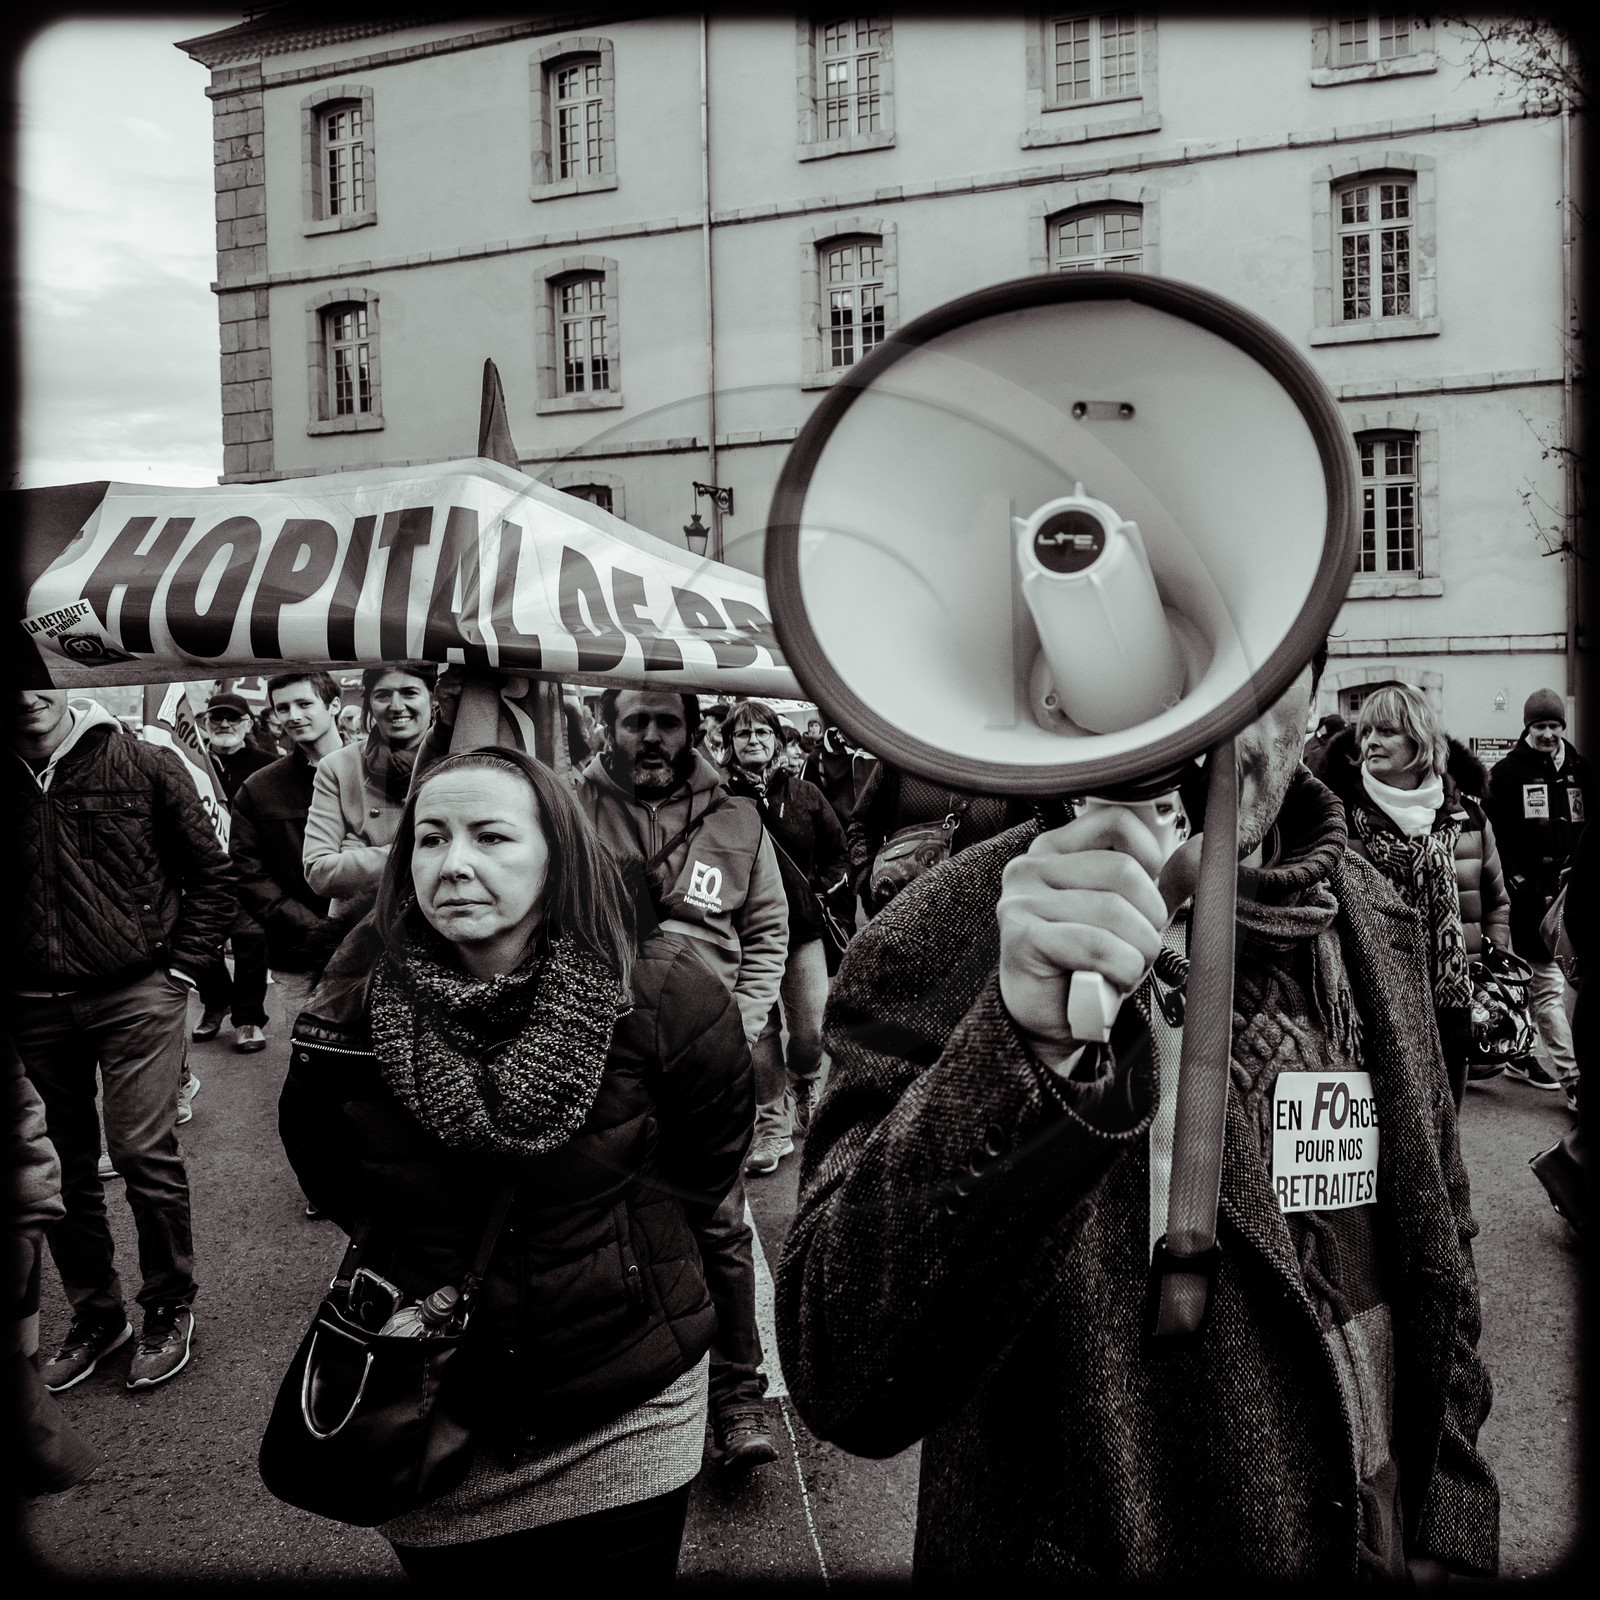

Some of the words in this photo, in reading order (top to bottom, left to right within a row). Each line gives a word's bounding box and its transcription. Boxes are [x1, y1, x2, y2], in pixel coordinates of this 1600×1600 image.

[80, 506, 543, 668] HOPITAL
[558, 545, 684, 671] DE
[23, 619, 41, 634] LA
[39, 602, 90, 630] RETRAITE
[45, 627, 57, 638] au
[55, 614, 82, 633] rabais
[71, 638, 94, 654] FO
[687, 860, 722, 898] FO
[1276, 1099, 1302, 1130] EN
[1311, 1082, 1379, 1131] FORCE
[1295, 1140, 1335, 1163] POUR
[1338, 1138, 1363, 1162] NOS
[1276, 1169, 1375, 1207] RETRAITES
